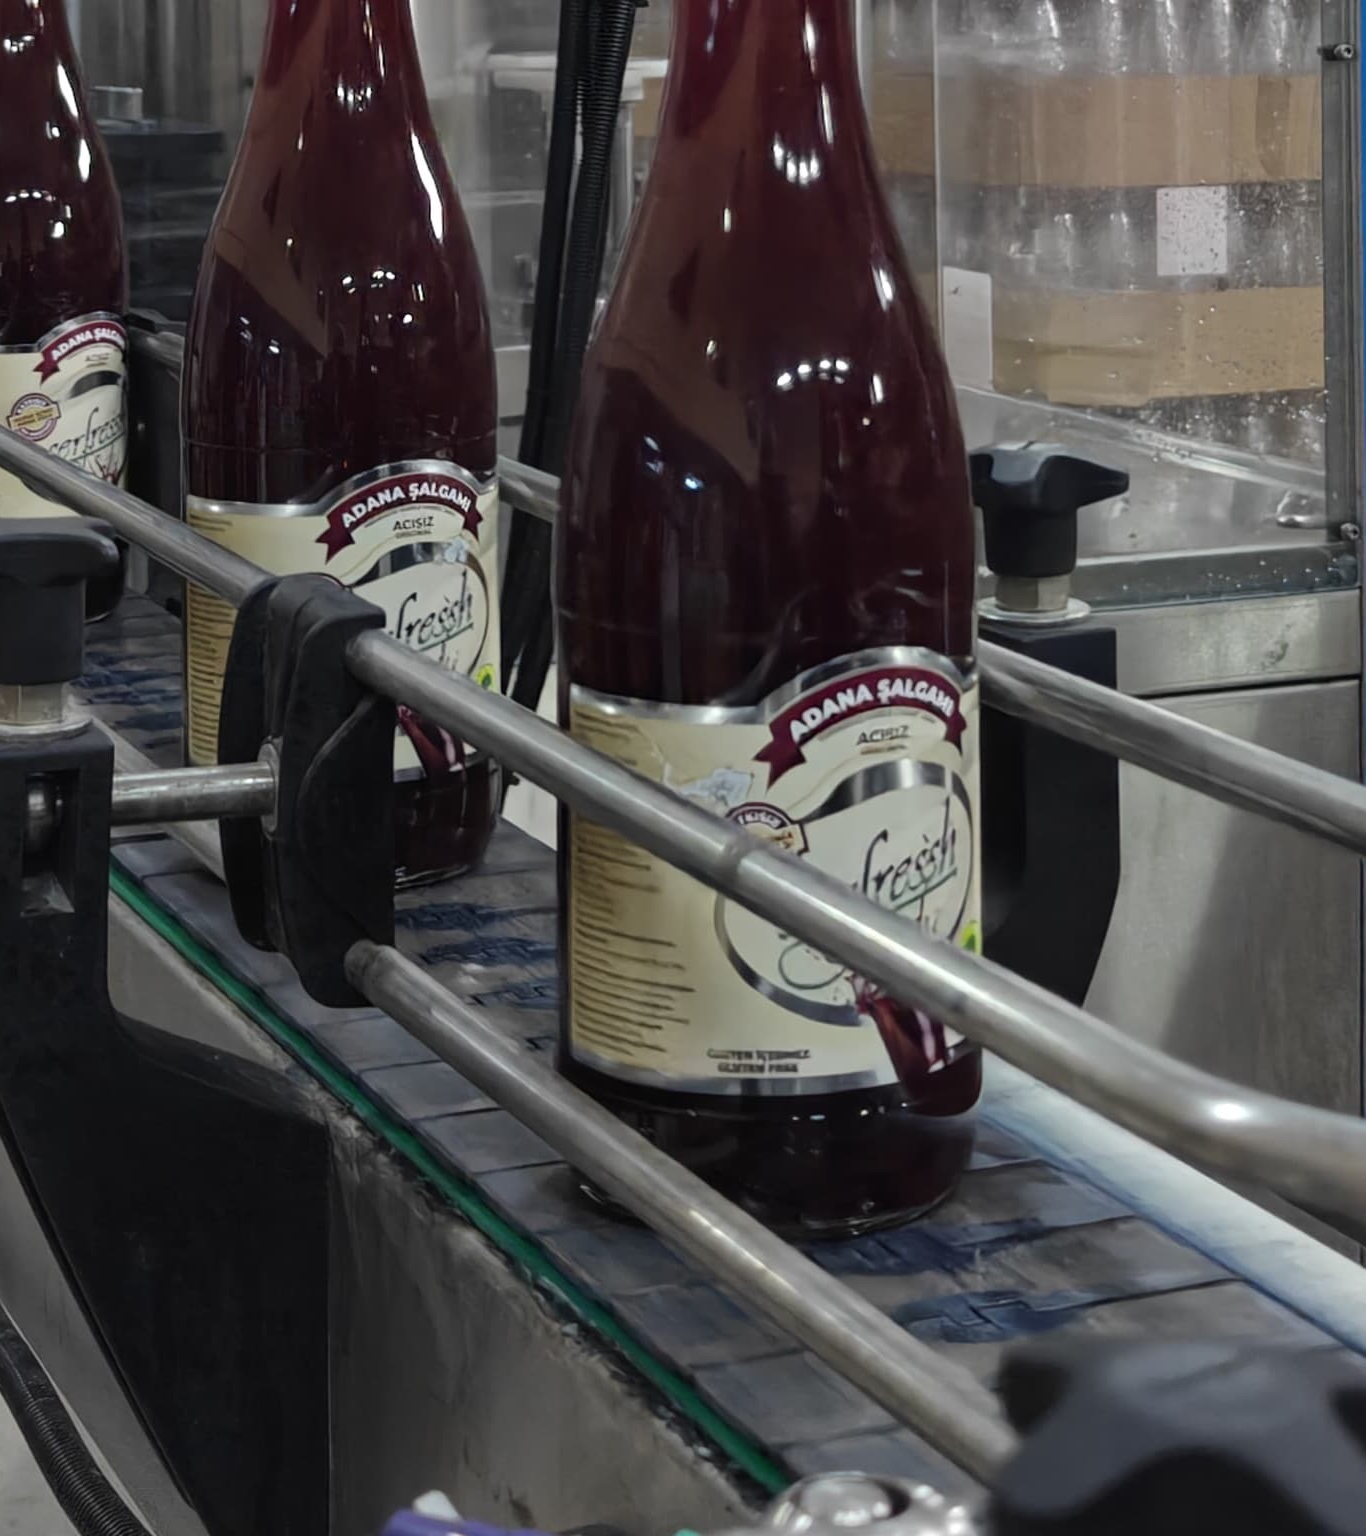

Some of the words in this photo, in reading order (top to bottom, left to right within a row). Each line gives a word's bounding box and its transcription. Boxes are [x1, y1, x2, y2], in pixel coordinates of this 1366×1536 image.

[51, 330, 94, 361] ADANA
[341, 486, 406, 528] ADANA
[408, 482, 471, 513] ŞALGAMI
[790, 684, 874, 743] ADANA
